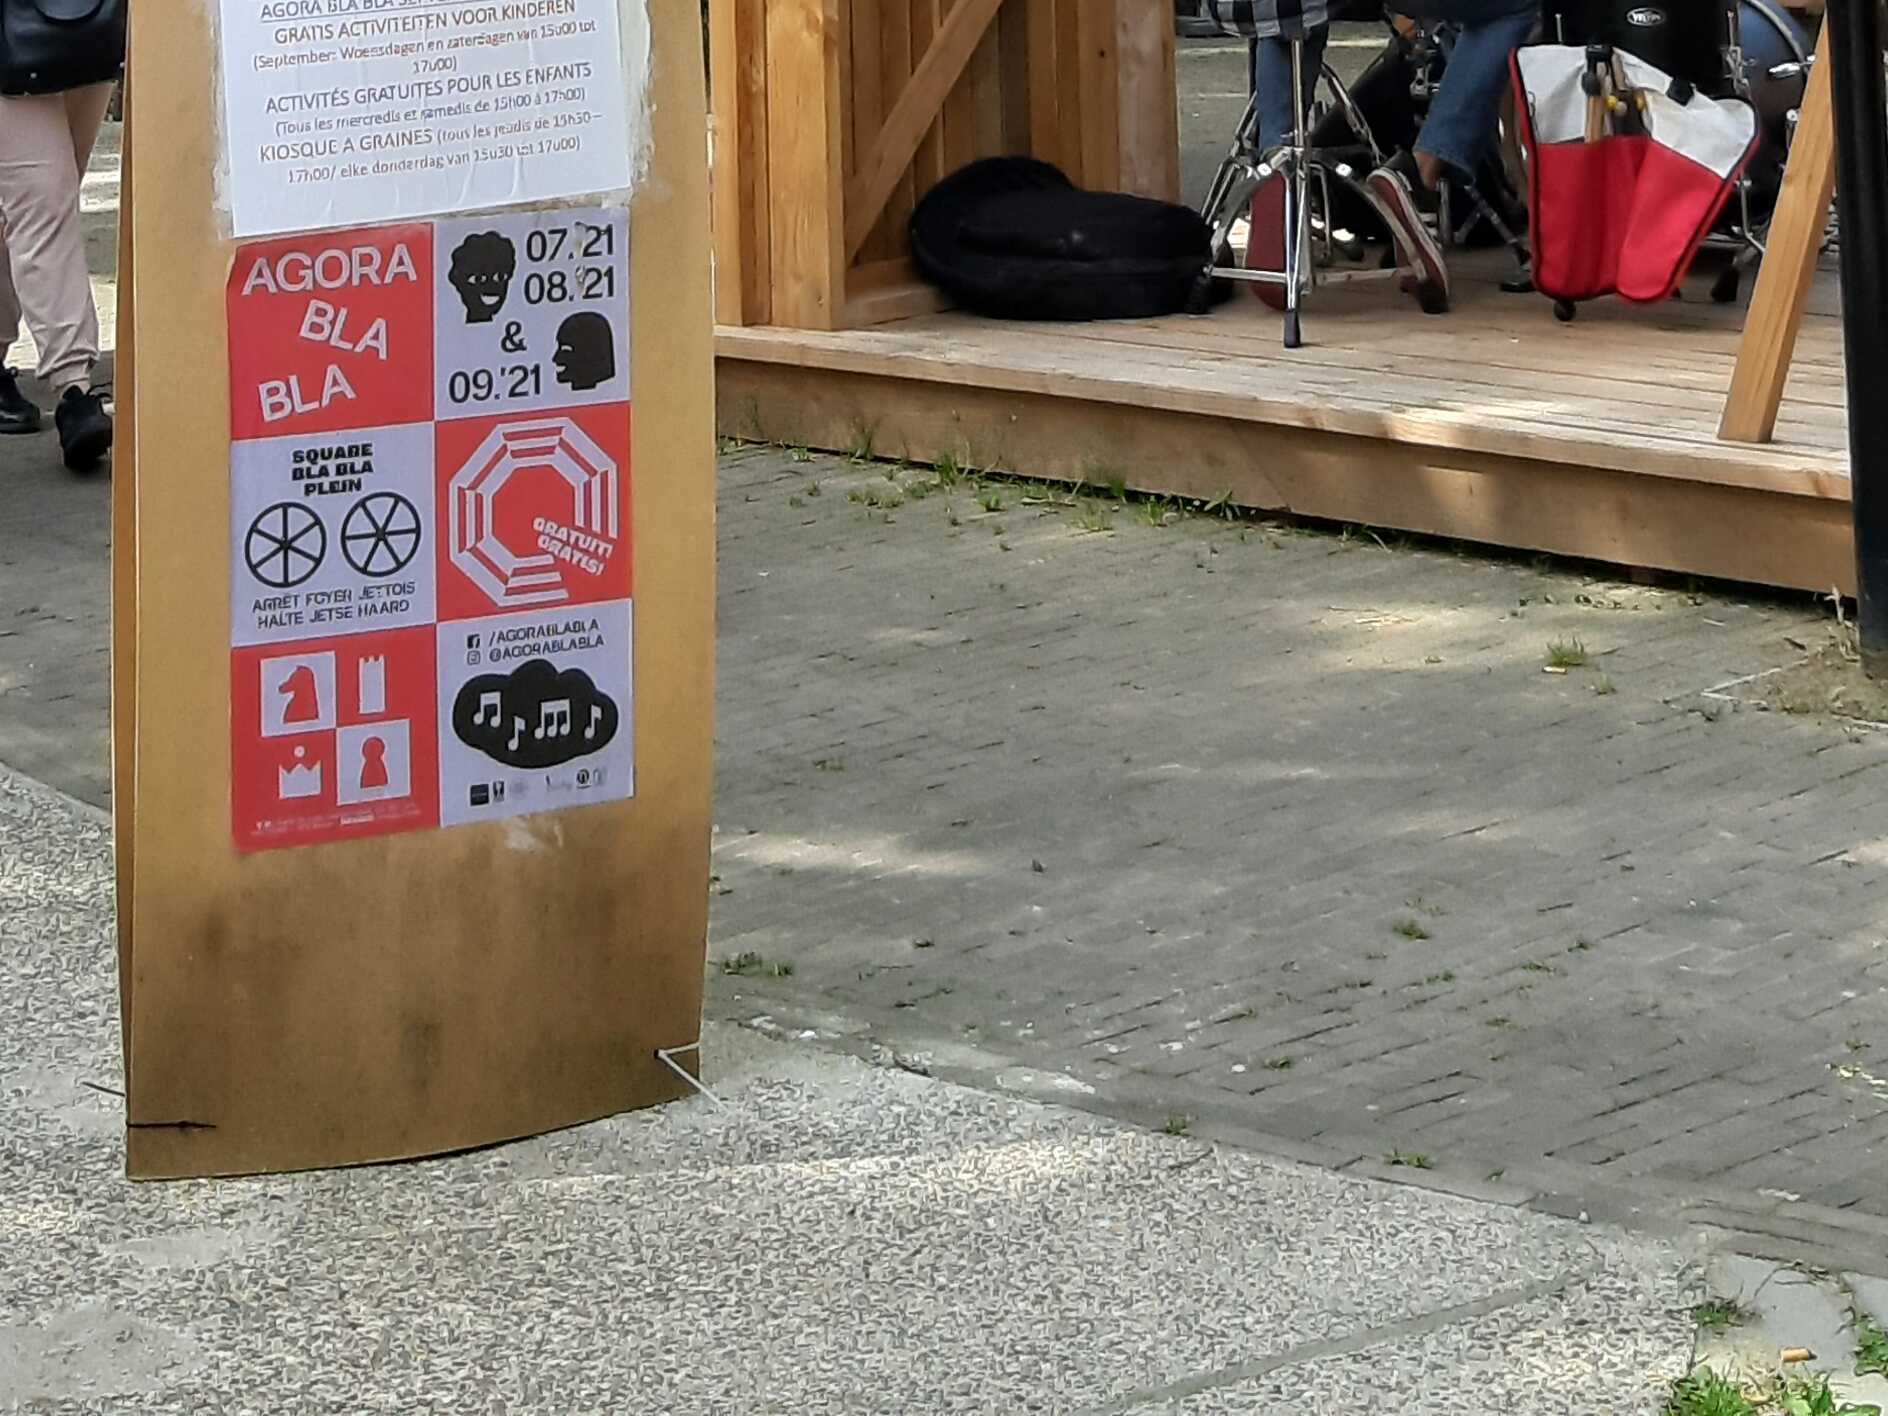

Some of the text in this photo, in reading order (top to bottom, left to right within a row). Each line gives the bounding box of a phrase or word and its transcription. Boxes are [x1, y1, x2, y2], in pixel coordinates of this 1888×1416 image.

[261, 0, 322, 18] AGORA
[274, 23, 334, 44] GRATIS
[338, 13, 448, 39] ACTIVITEITEN
[451, 6, 497, 26] VOOR
[428, 39, 444, 52] en
[517, 27, 538, 41] van
[579, 19, 596, 33] tot
[266, 61, 592, 114] ACTIVITÉS GRATUITES POUR LES ENFANTS
[275, 121, 312, 137] (Tous
[314, 117, 333, 131] les
[336, 109, 401, 128] mercredis
[404, 109, 417, 121] et
[474, 99, 490, 113] de
[260, 139, 338, 163] KIOSQUE
[359, 128, 434, 151] GRAINES
[436, 128, 470, 145] (tous
[473, 123, 491, 139] les
[493, 118, 531, 139] jeudis
[534, 116, 550, 130] de
[340, 163, 369, 178] elke
[372, 155, 445, 174] donderdag
[447, 152, 470, 165] van
[241, 243, 418, 296] AGORA
[298, 298, 388, 361] BLA
[500, 320, 528, 354] &
[257, 364, 358, 422] BLA
[292, 443, 374, 466] SQUARE
[292, 460, 374, 481] BLA BLA
[303, 478, 362, 497] PLEIN
[305, 588, 352, 607] FOYER
[358, 581, 416, 600] JETTOIS
[257, 599, 410, 629] HALTE JETSE HAARD
